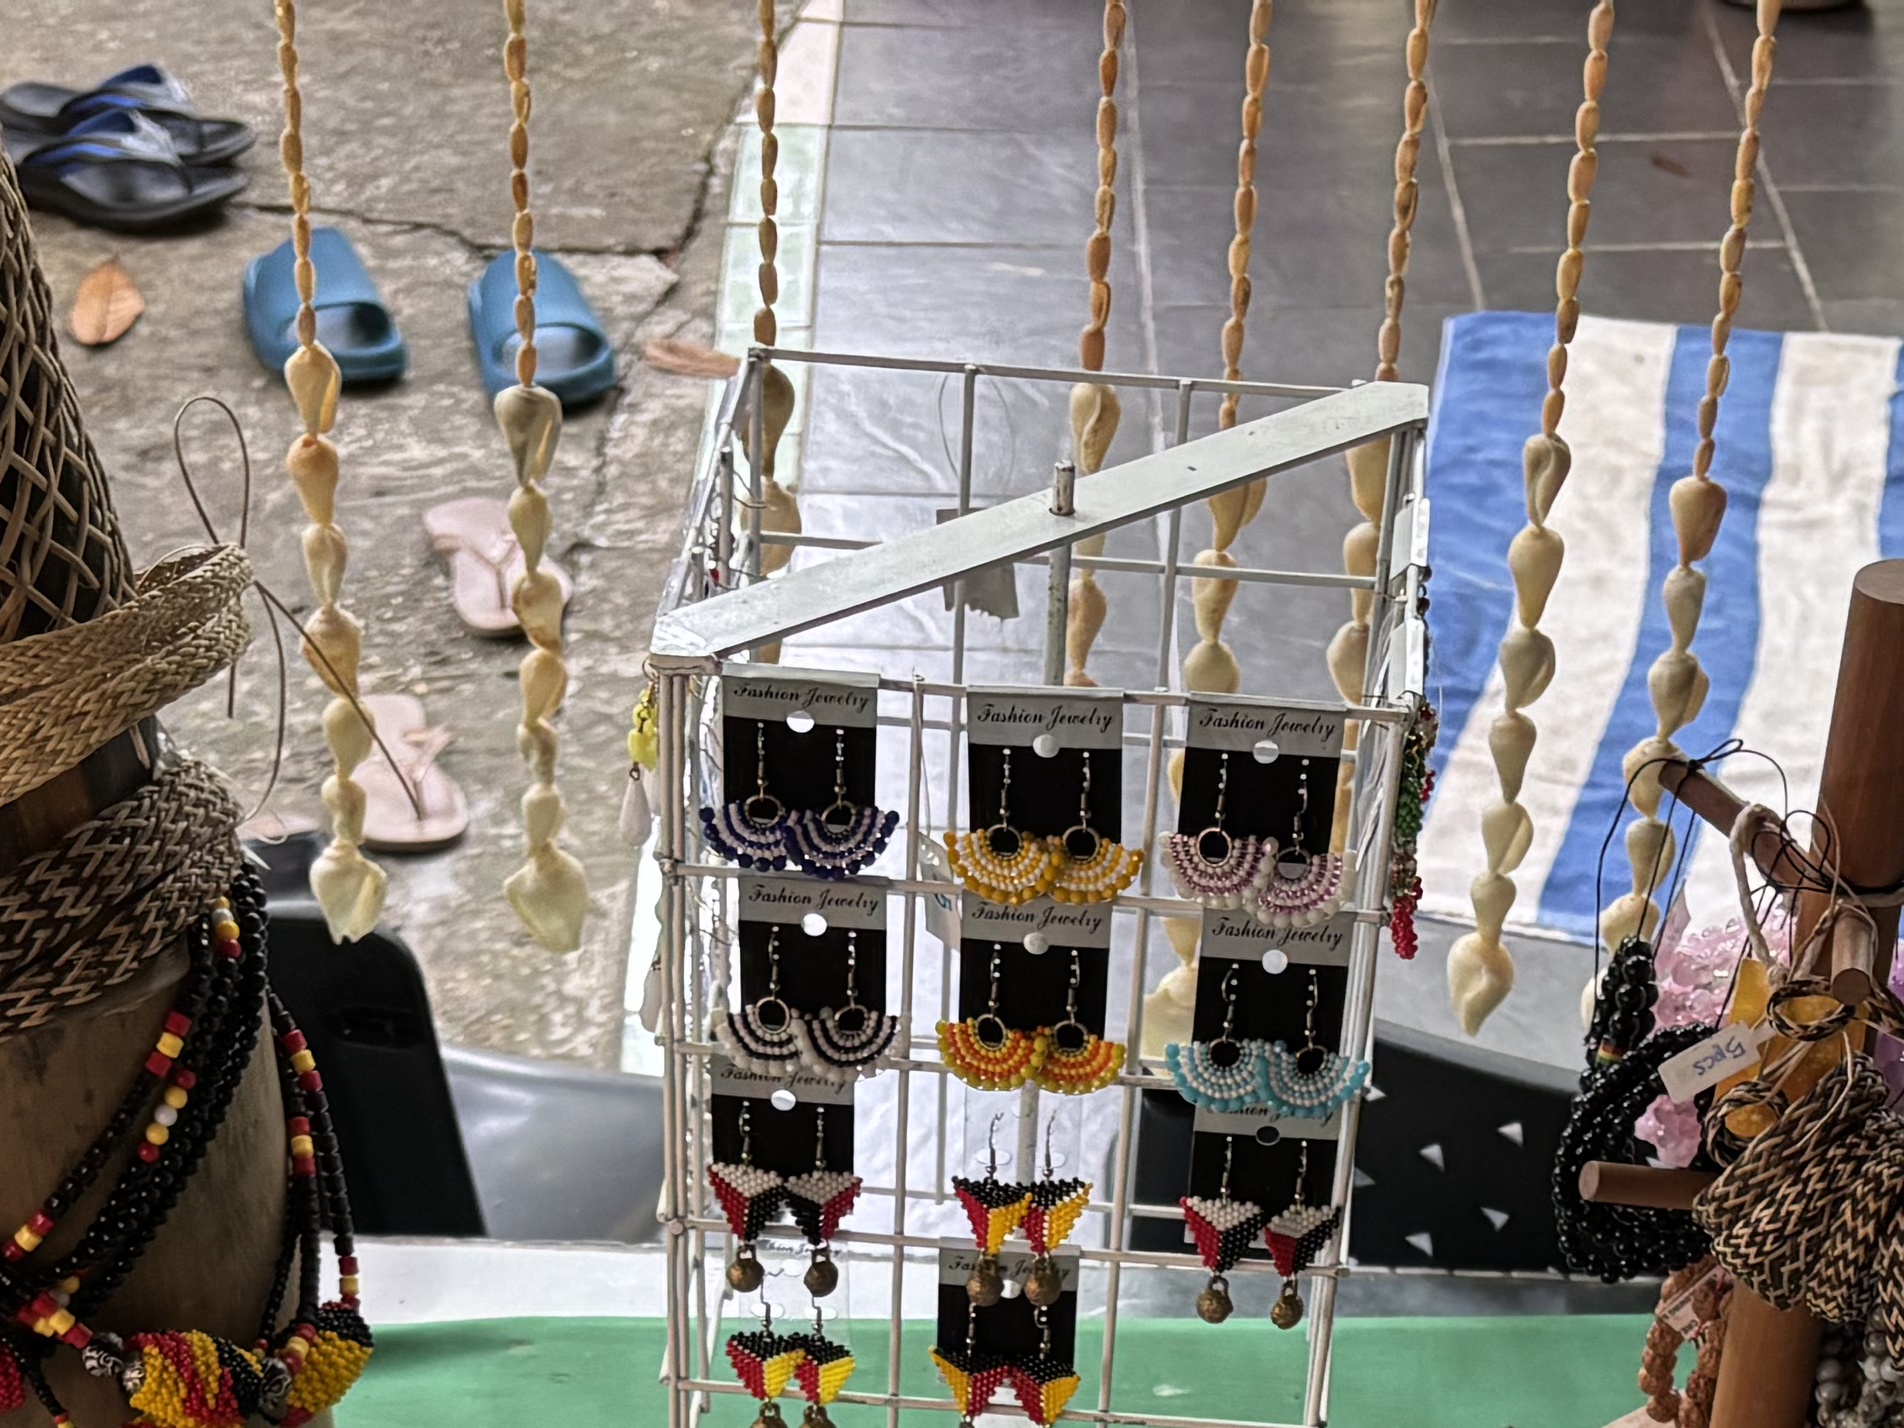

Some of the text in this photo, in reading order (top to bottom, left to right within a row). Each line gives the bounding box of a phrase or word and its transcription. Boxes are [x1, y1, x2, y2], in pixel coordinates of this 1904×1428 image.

[733, 682, 870, 713] Fashion Jewelry
[977, 702, 1114, 731] Fashion Jewelry
[1198, 708, 1336, 740] Fashion Jewelry
[747, 884, 880, 914] Fashion Jewelry
[971, 901, 1034, 922] Fashion
[1037, 906, 1102, 935] Jewelry
[1212, 917, 1343, 951] Fashion Jewelry
[1693, 1036, 1746, 1076] 5pcs
